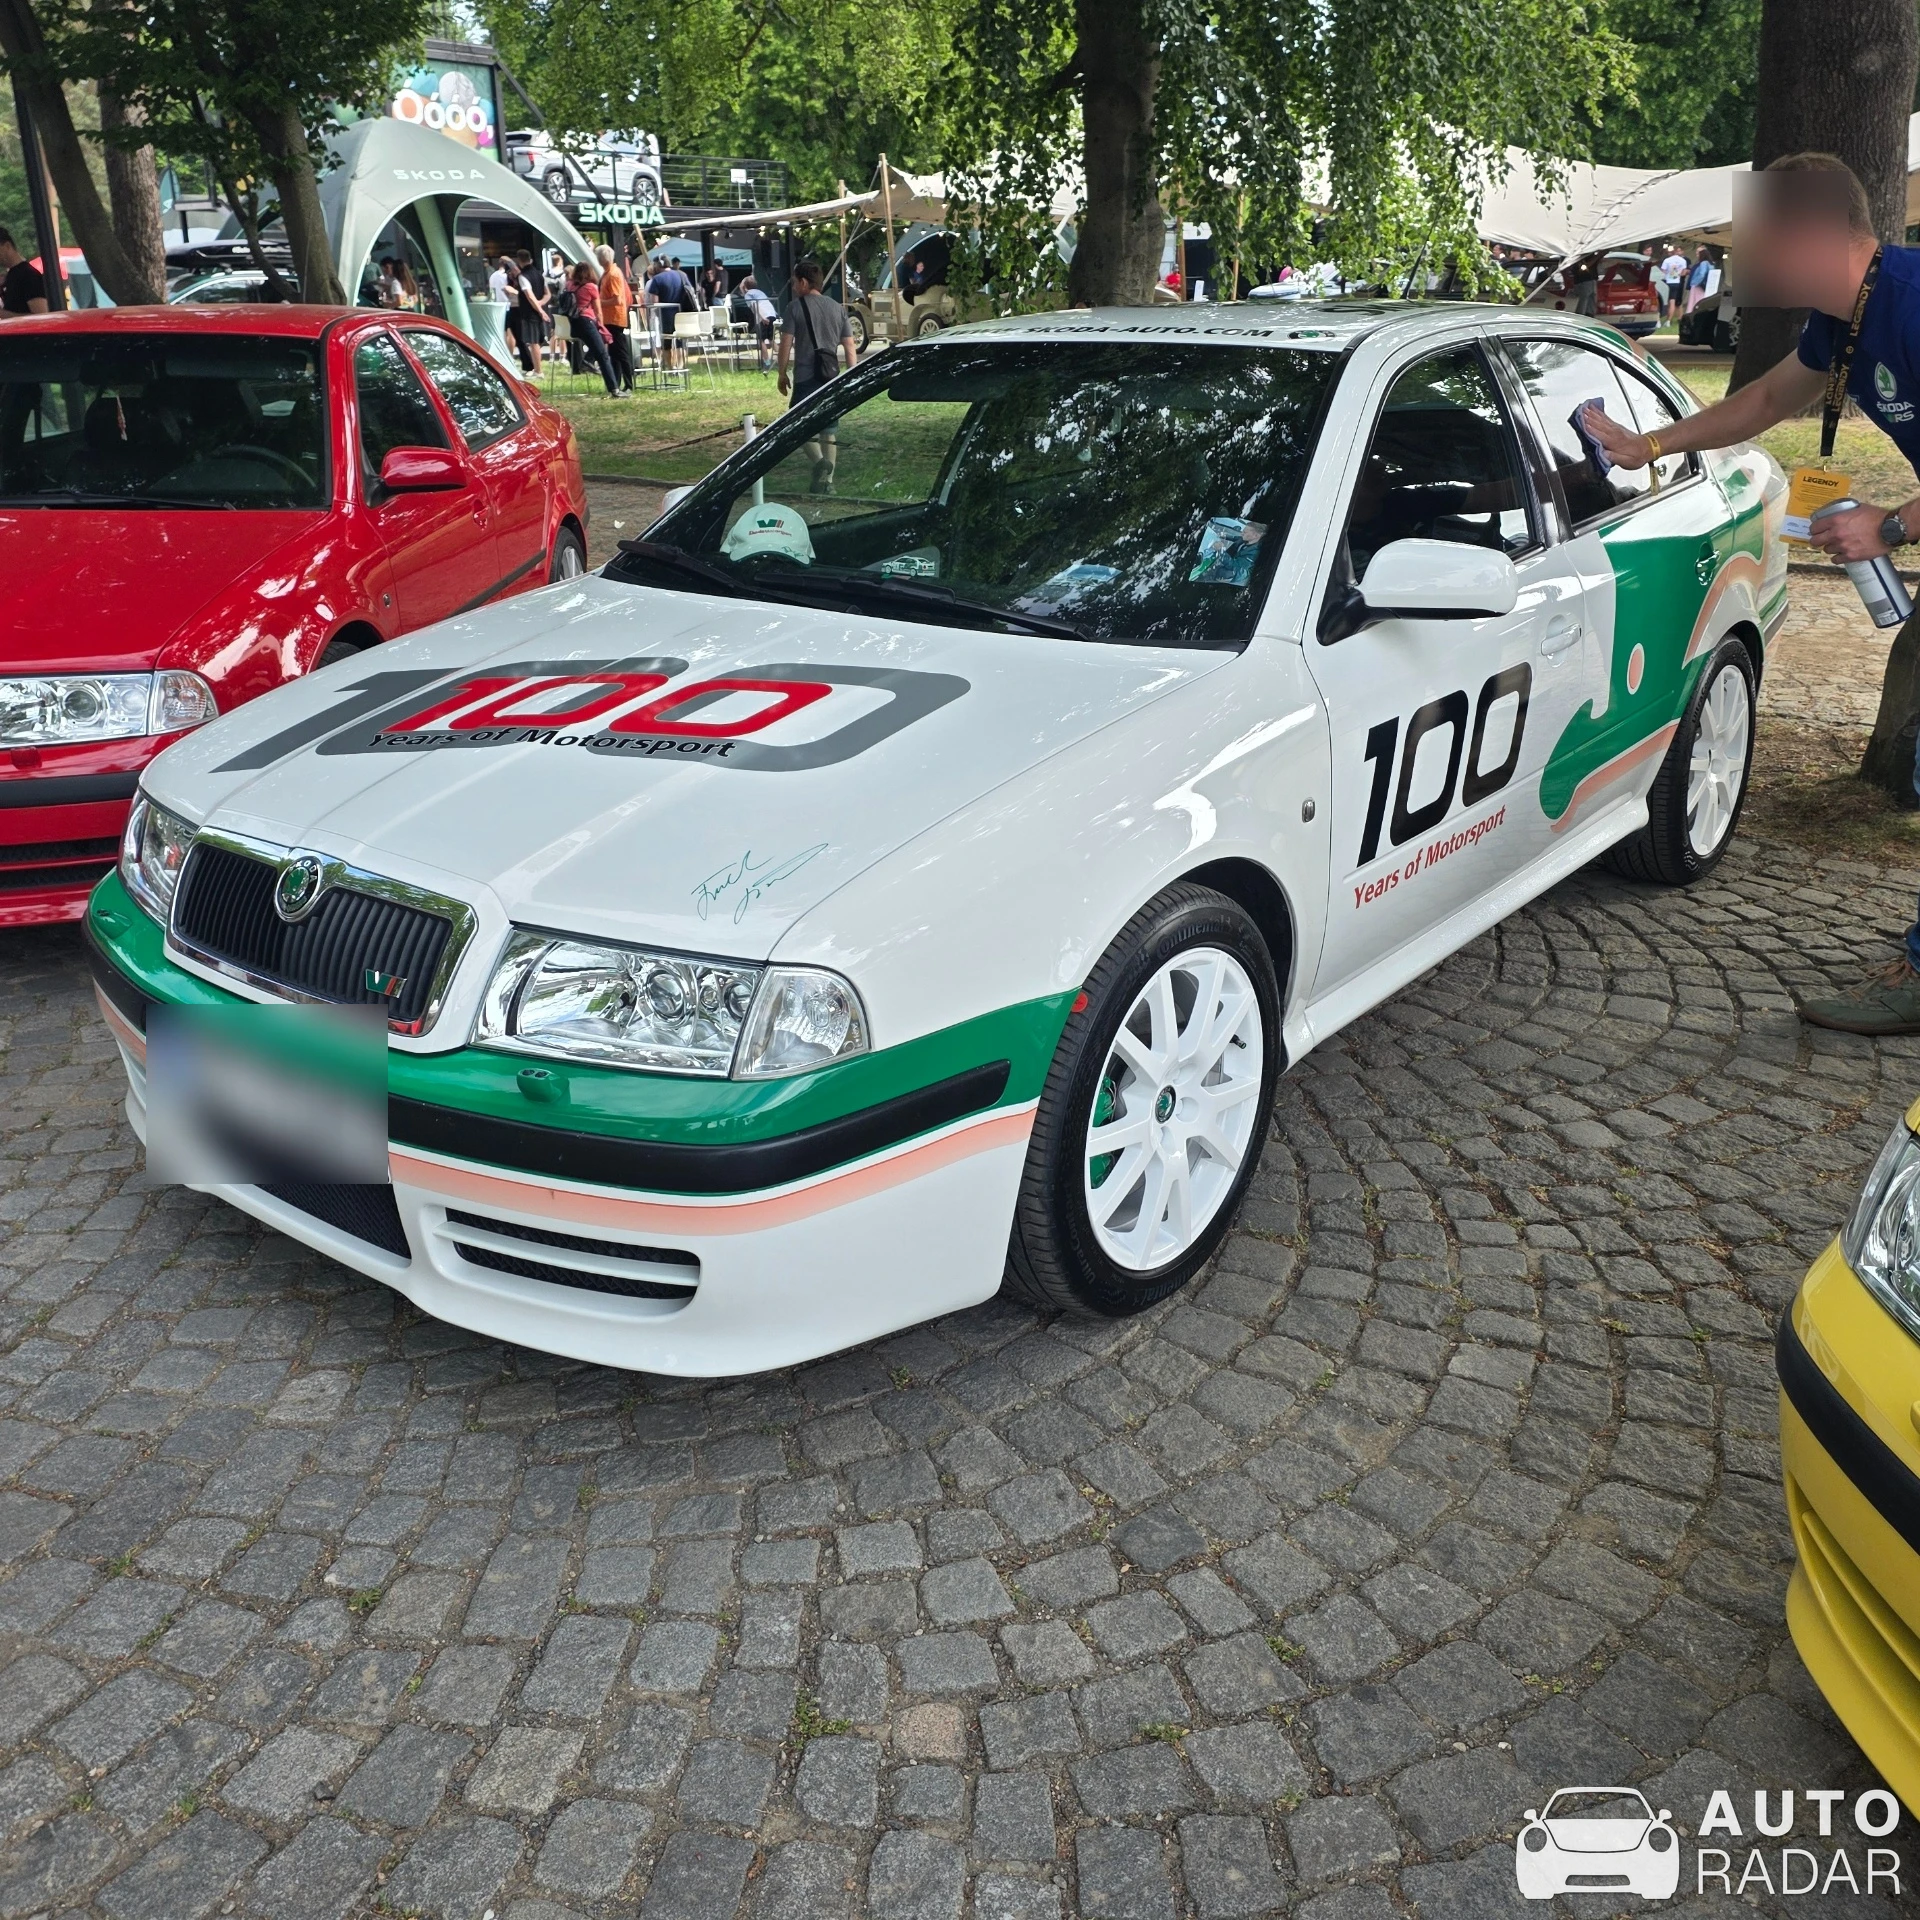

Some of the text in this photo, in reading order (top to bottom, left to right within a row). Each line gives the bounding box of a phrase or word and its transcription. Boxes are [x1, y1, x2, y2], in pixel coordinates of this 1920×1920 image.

[947, 325, 1274, 338] WWWSKODA-AUTO.COM
[1850, 282, 1872, 337] LEGENDY
[1831, 363, 1850, 413] LEGENDY
[1802, 475, 1839, 488] LEGENDY
[379, 671, 834, 739] 100
[367, 727, 740, 758] Years of Motorsport
[1356, 661, 1533, 868] 100
[1354, 804, 1507, 910] Years of Motorsport
